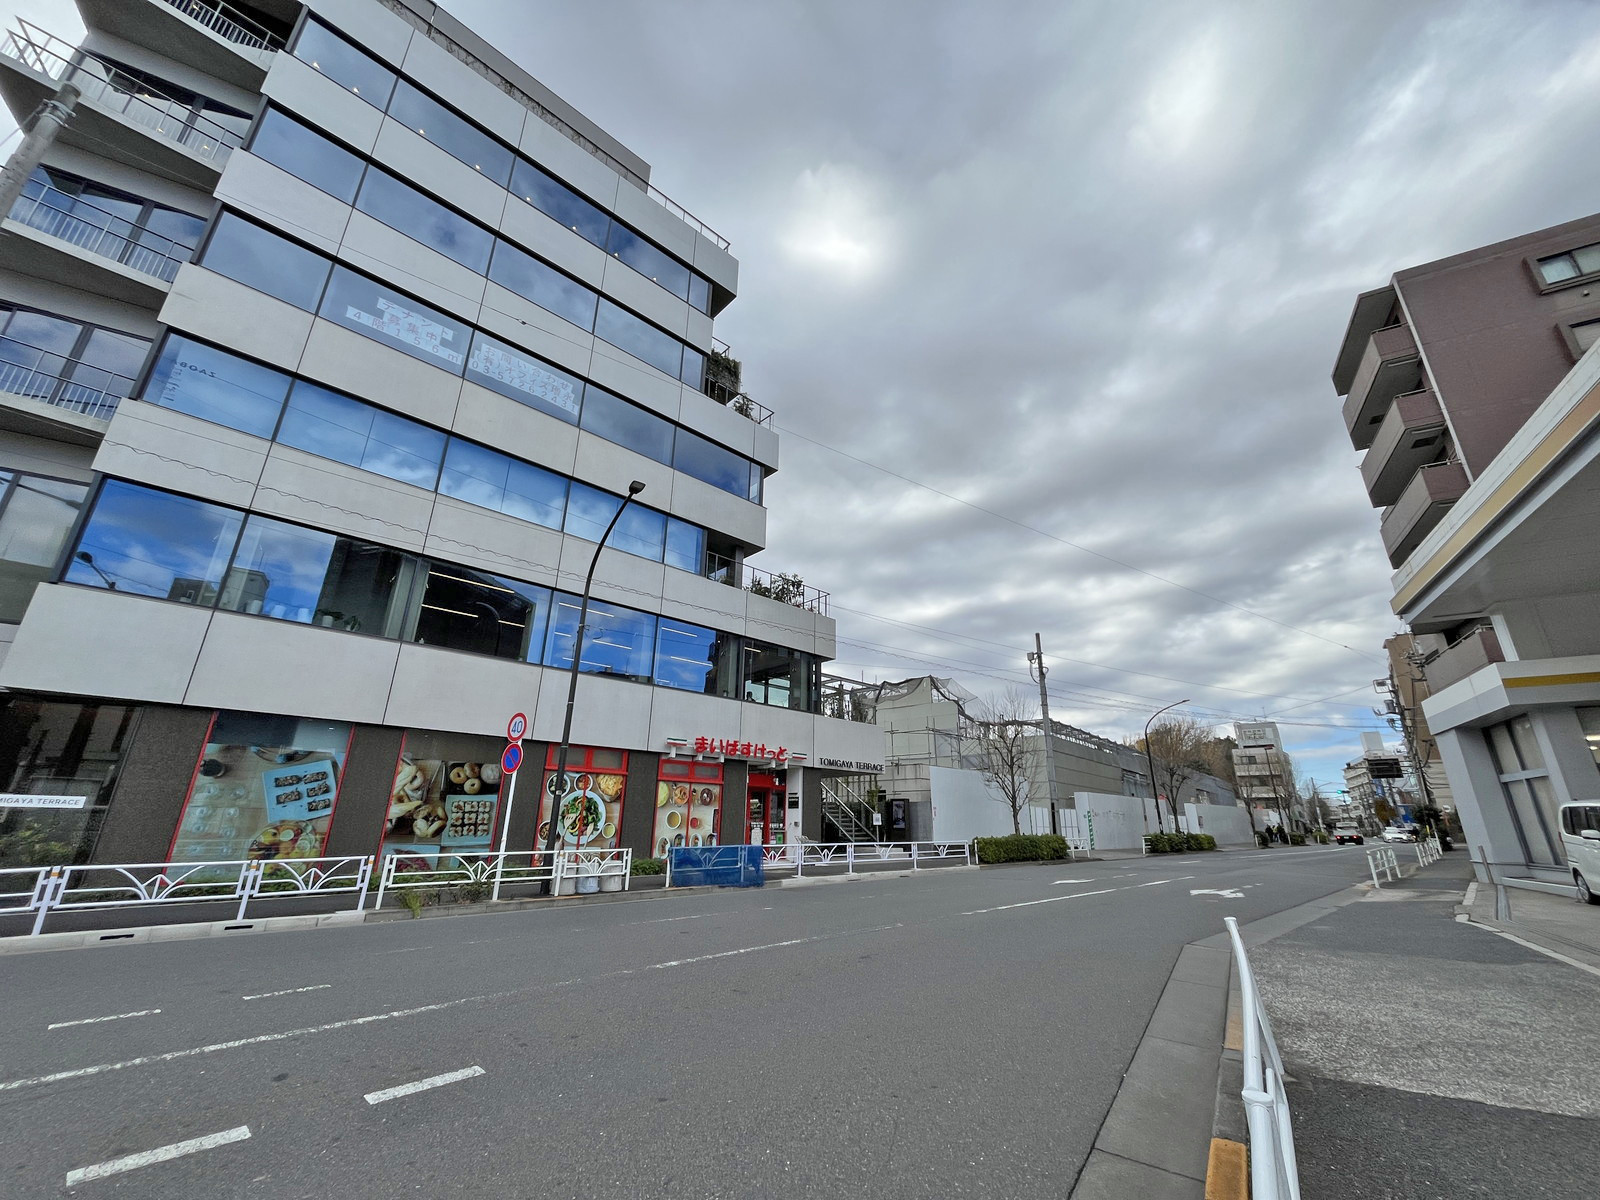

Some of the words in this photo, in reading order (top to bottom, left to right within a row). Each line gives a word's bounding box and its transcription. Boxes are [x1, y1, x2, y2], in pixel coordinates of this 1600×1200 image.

[382, 302, 449, 338] テナント
[387, 313, 437, 342] 募集中
[484, 347, 570, 391] お問い合わせ
[511, 720, 523, 734] 40
[695, 736, 788, 762] まいばすけっと
[819, 757, 854, 769] TOMIGAYA
[855, 761, 885, 772] TERRACE
[38, 798, 80, 806] TERRACE
